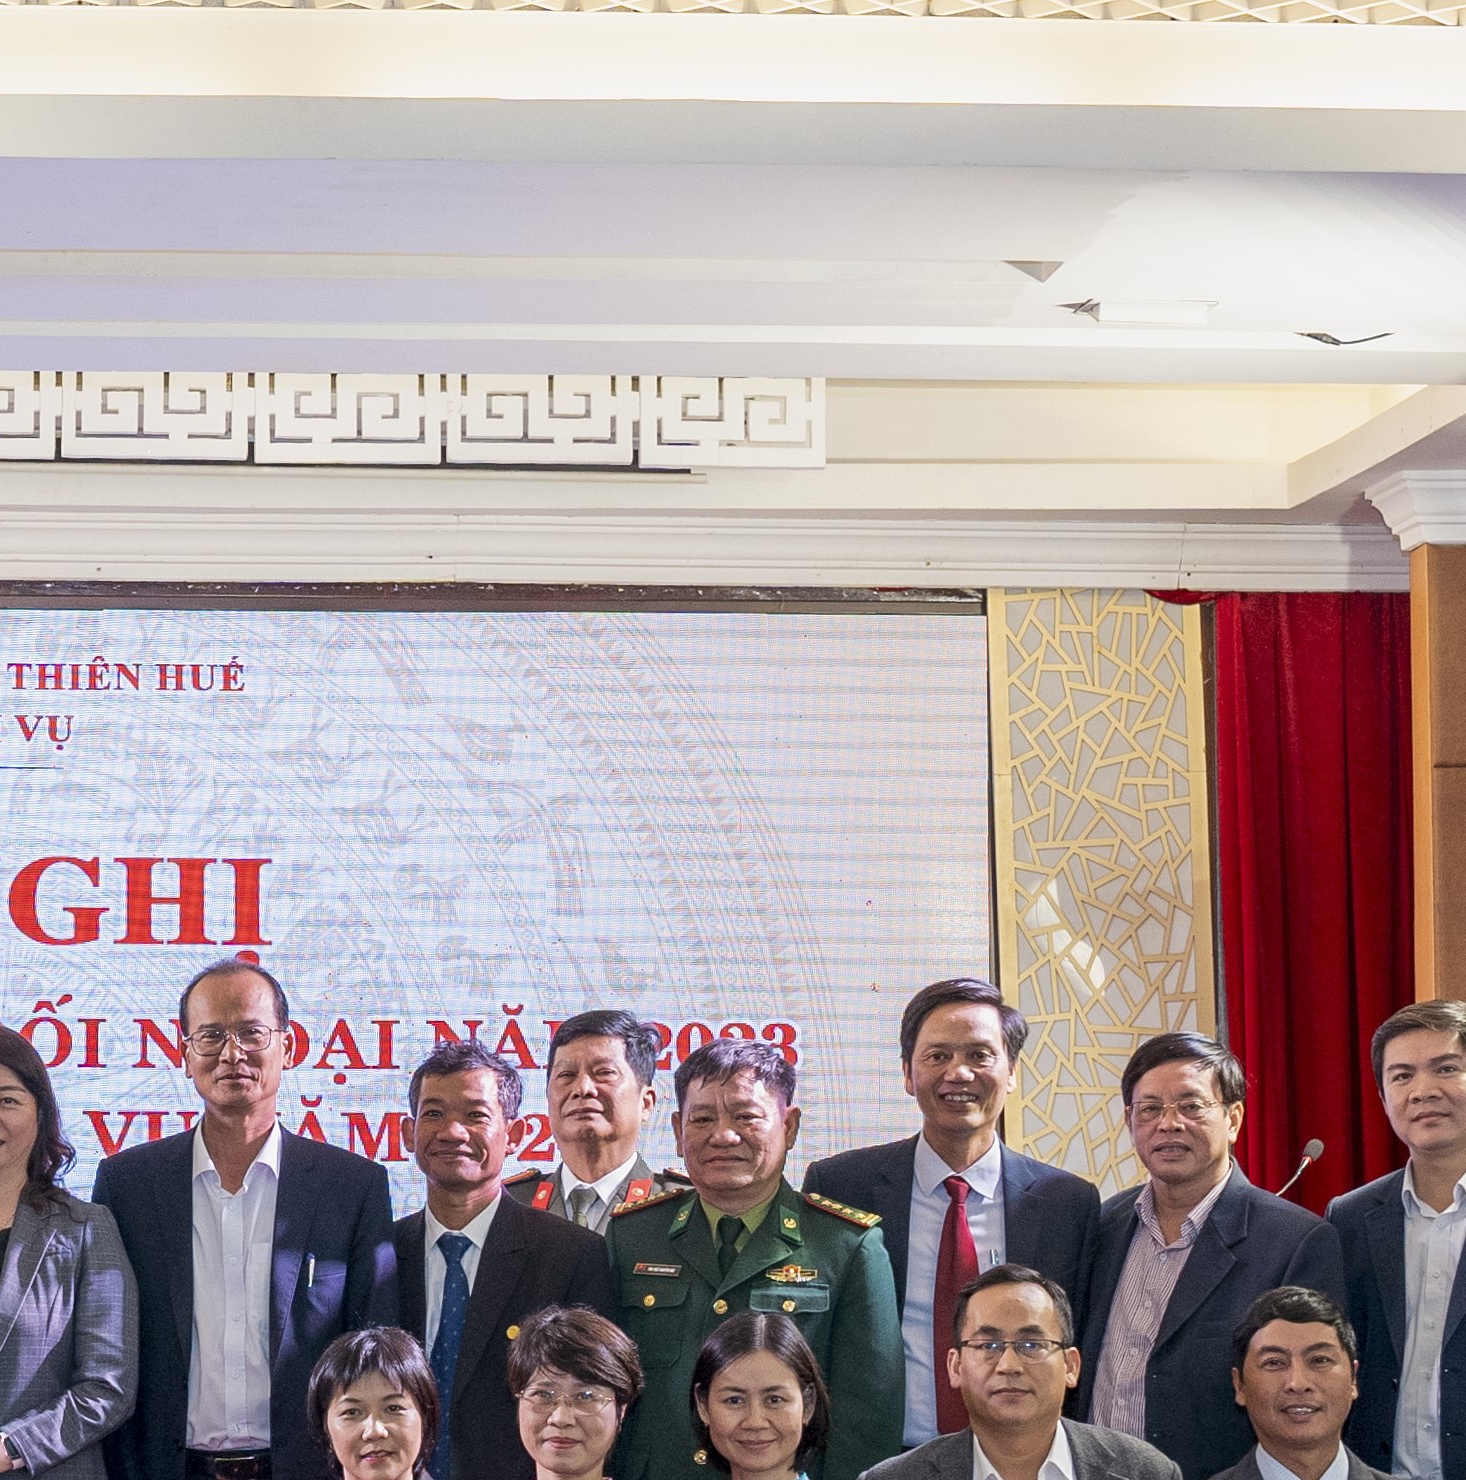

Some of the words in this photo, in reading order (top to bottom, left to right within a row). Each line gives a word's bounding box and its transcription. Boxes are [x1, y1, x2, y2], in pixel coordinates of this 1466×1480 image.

[6, 656, 141, 690] THIÊN
[156, 658, 246, 691] HUẾ
[15, 714, 74, 750] VỤ
[281, 1095, 409, 1161] ĂM
